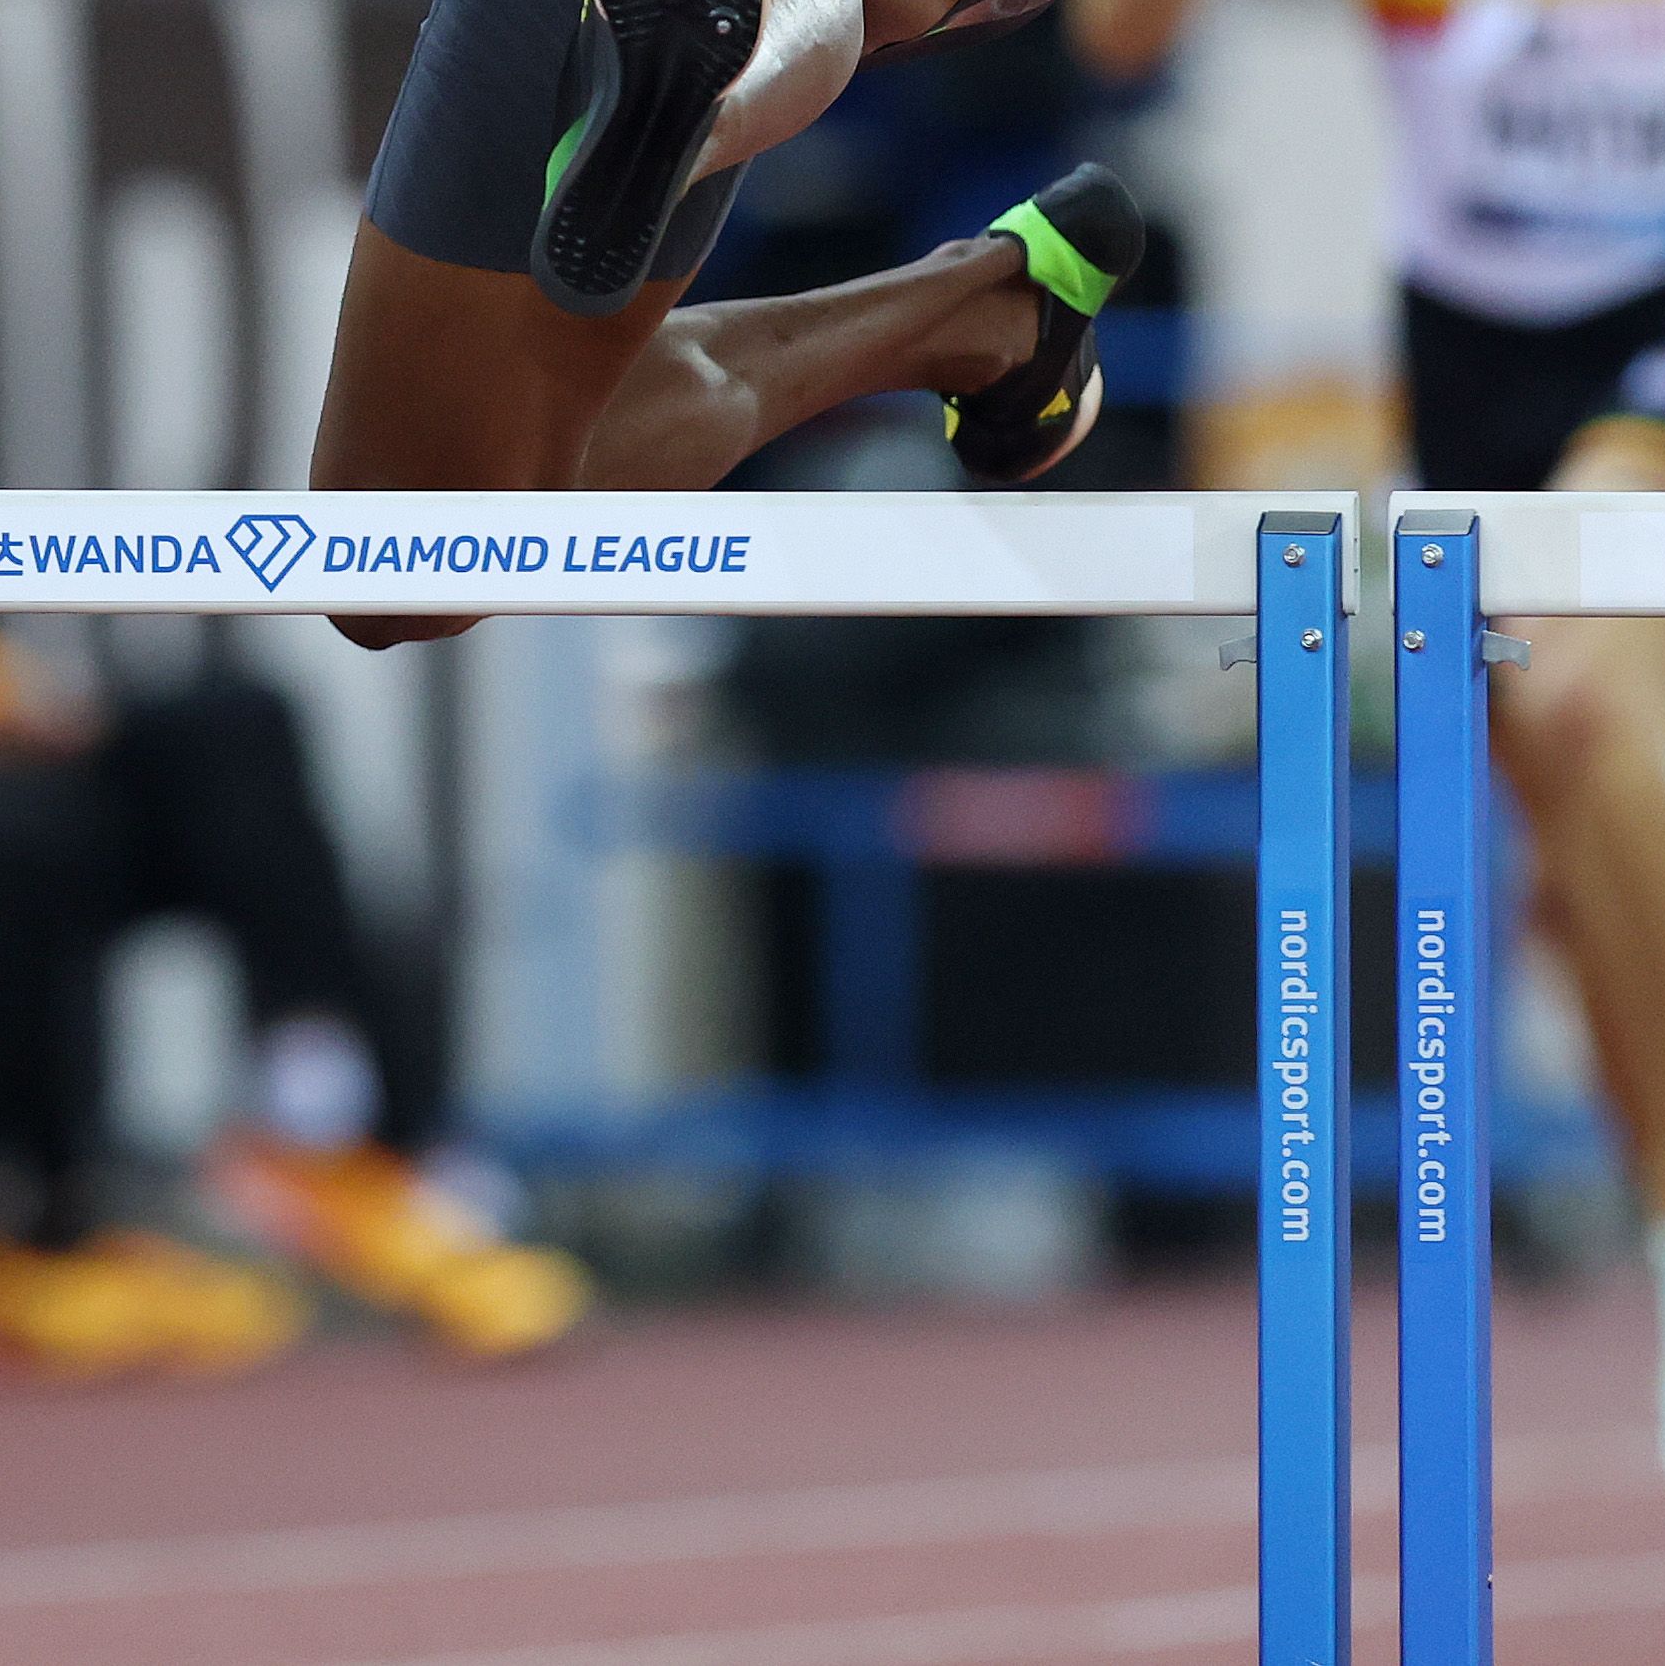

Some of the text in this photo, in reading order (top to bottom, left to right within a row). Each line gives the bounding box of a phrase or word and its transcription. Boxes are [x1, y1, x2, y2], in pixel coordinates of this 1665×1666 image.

[30, 535, 222, 573] WANDA
[322, 535, 549, 573] DIAMOND
[563, 535, 752, 573] LEAGUE
[1272, 909, 1319, 1243] nordicsport.com
[1408, 909, 1456, 1243] nordicsport.com
